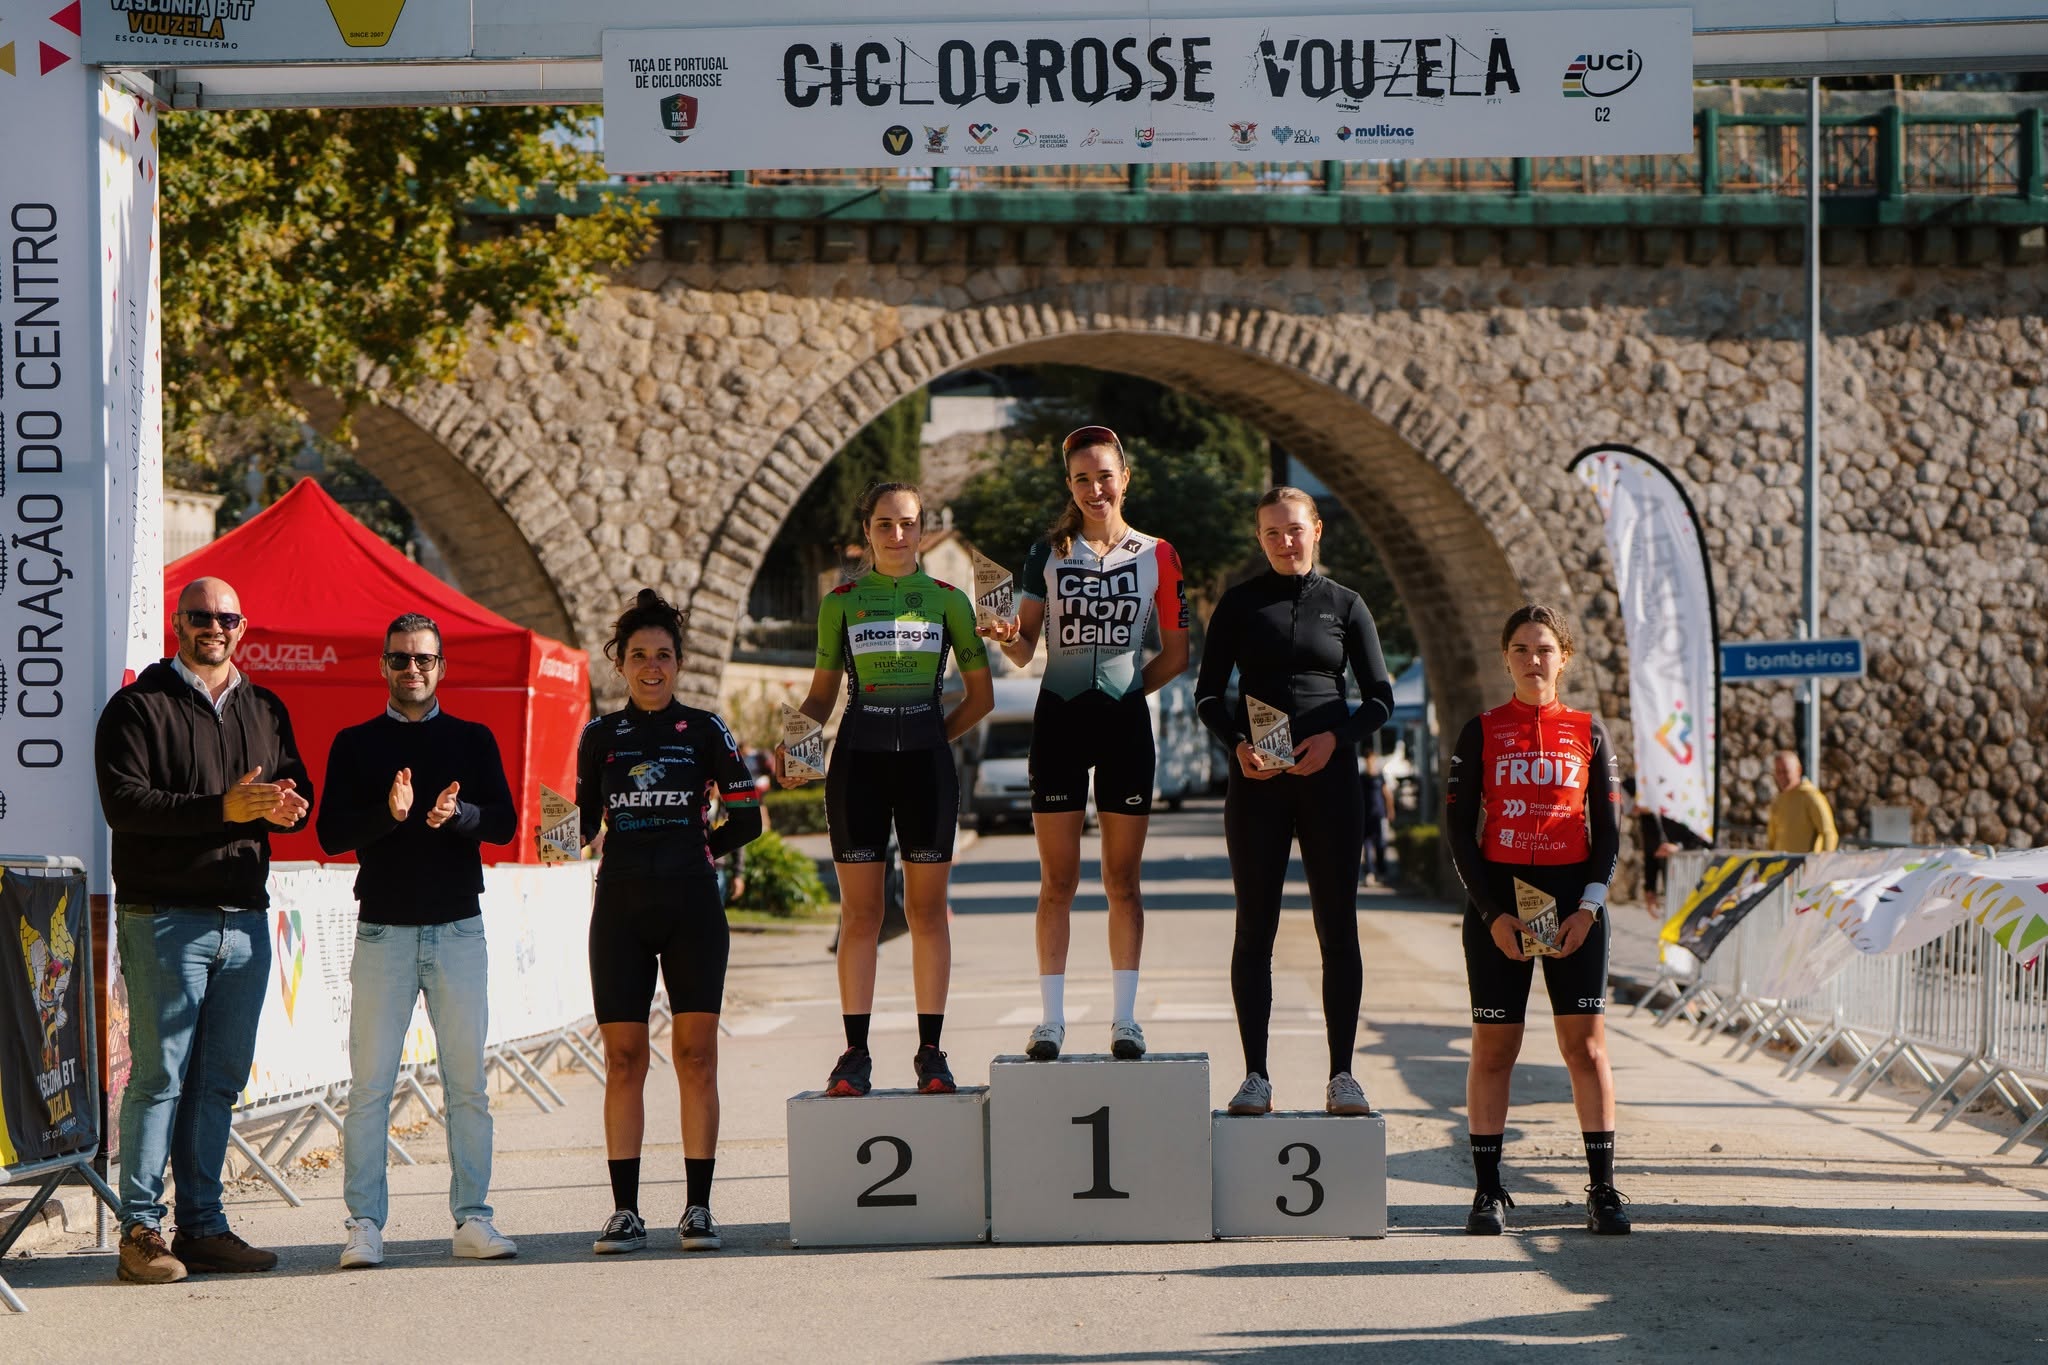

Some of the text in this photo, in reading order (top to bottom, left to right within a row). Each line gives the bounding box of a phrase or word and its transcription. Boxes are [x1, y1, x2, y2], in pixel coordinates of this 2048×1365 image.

[216, 0, 255, 21] BTT
[128, 12, 225, 40] VOUZELA
[115, 34, 238, 50] ESCOLA DE CICLISMO
[628, 57, 728, 74] TAÇA DE PORTUGAL
[783, 37, 1520, 107] CICLOCROSSE VOUZELA
[635, 73, 722, 88] DE CICLOCROSSE
[671, 111, 688, 123] TAÇA
[1594, 107, 1611, 122] C2
[1355, 124, 1414, 137] multisac
[11, 203, 73, 768] O CORAÇÃO DO CENTRO
[1060, 571, 1136, 598] can
[1065, 597, 1138, 622] non
[1061, 618, 1130, 645] dale
[233, 643, 338, 664] VOUZELA
[1062, 647, 1127, 657] FACTORY RACING
[1744, 650, 1855, 669] bombeiros
[863, 705, 896, 714] SERFEY
[1496, 751, 1582, 763] supermercados
[1495, 758, 1582, 788] FROIZ
[609, 791, 691, 809] SAERTEX
[1530, 803, 1571, 811] Deputación
[1517, 831, 1549, 841] XUNTA
[1515, 841, 1567, 850] DE GALICIA
[1071, 1106, 1130, 1200] 1
[856, 1135, 917, 1208] 2
[1276, 1142, 1325, 1217] 3
